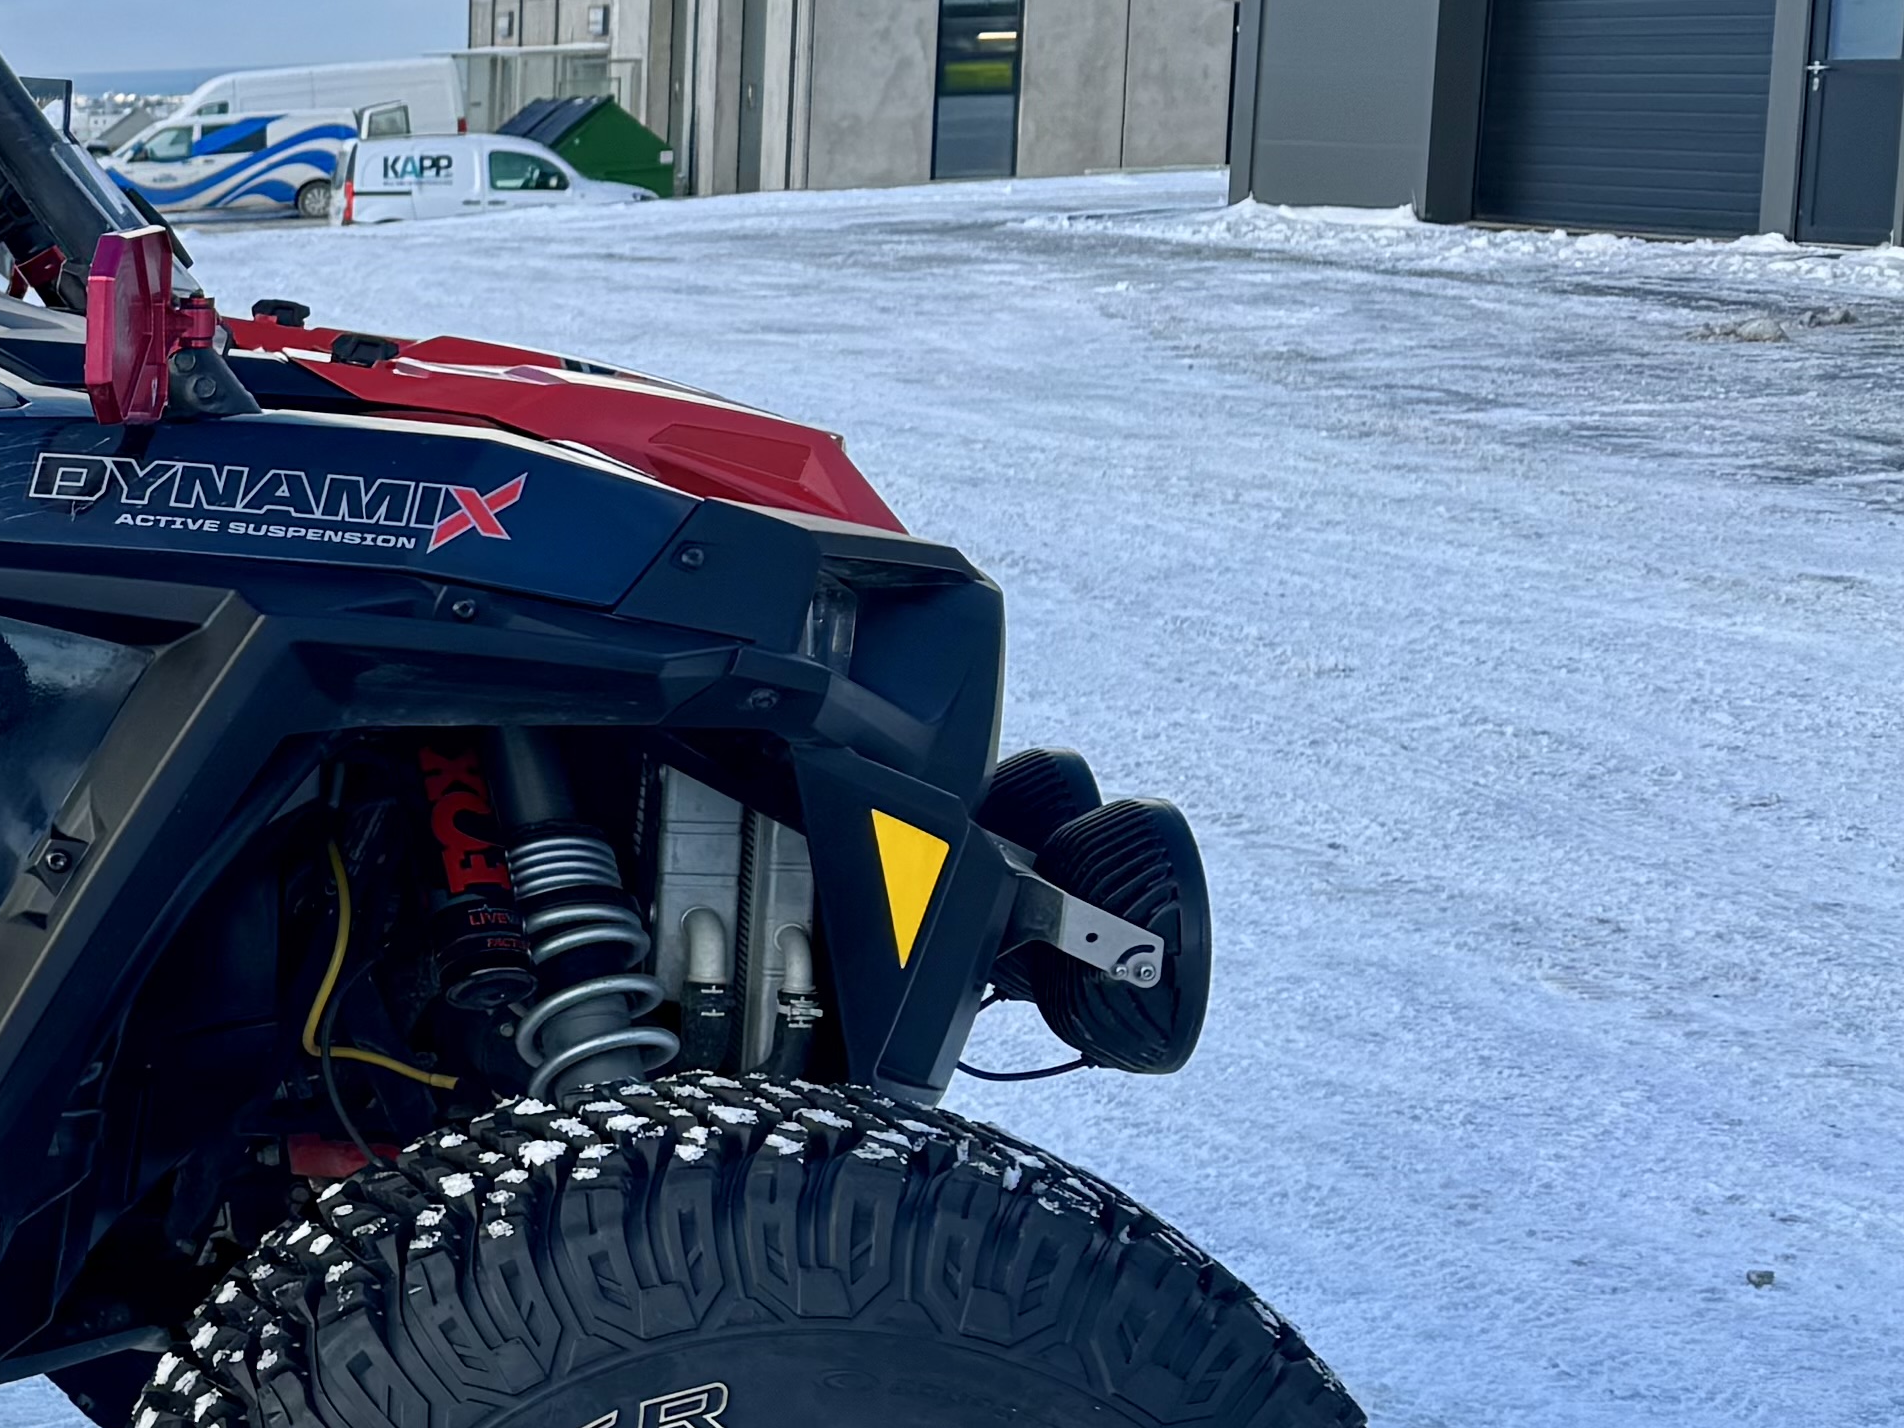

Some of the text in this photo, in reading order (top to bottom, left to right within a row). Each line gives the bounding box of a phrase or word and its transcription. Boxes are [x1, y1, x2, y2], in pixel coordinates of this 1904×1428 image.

[383, 155, 453, 179] KAPP
[29, 452, 528, 554] DYNAMIX
[114, 513, 416, 550] ACTIVE SUSPENSION
